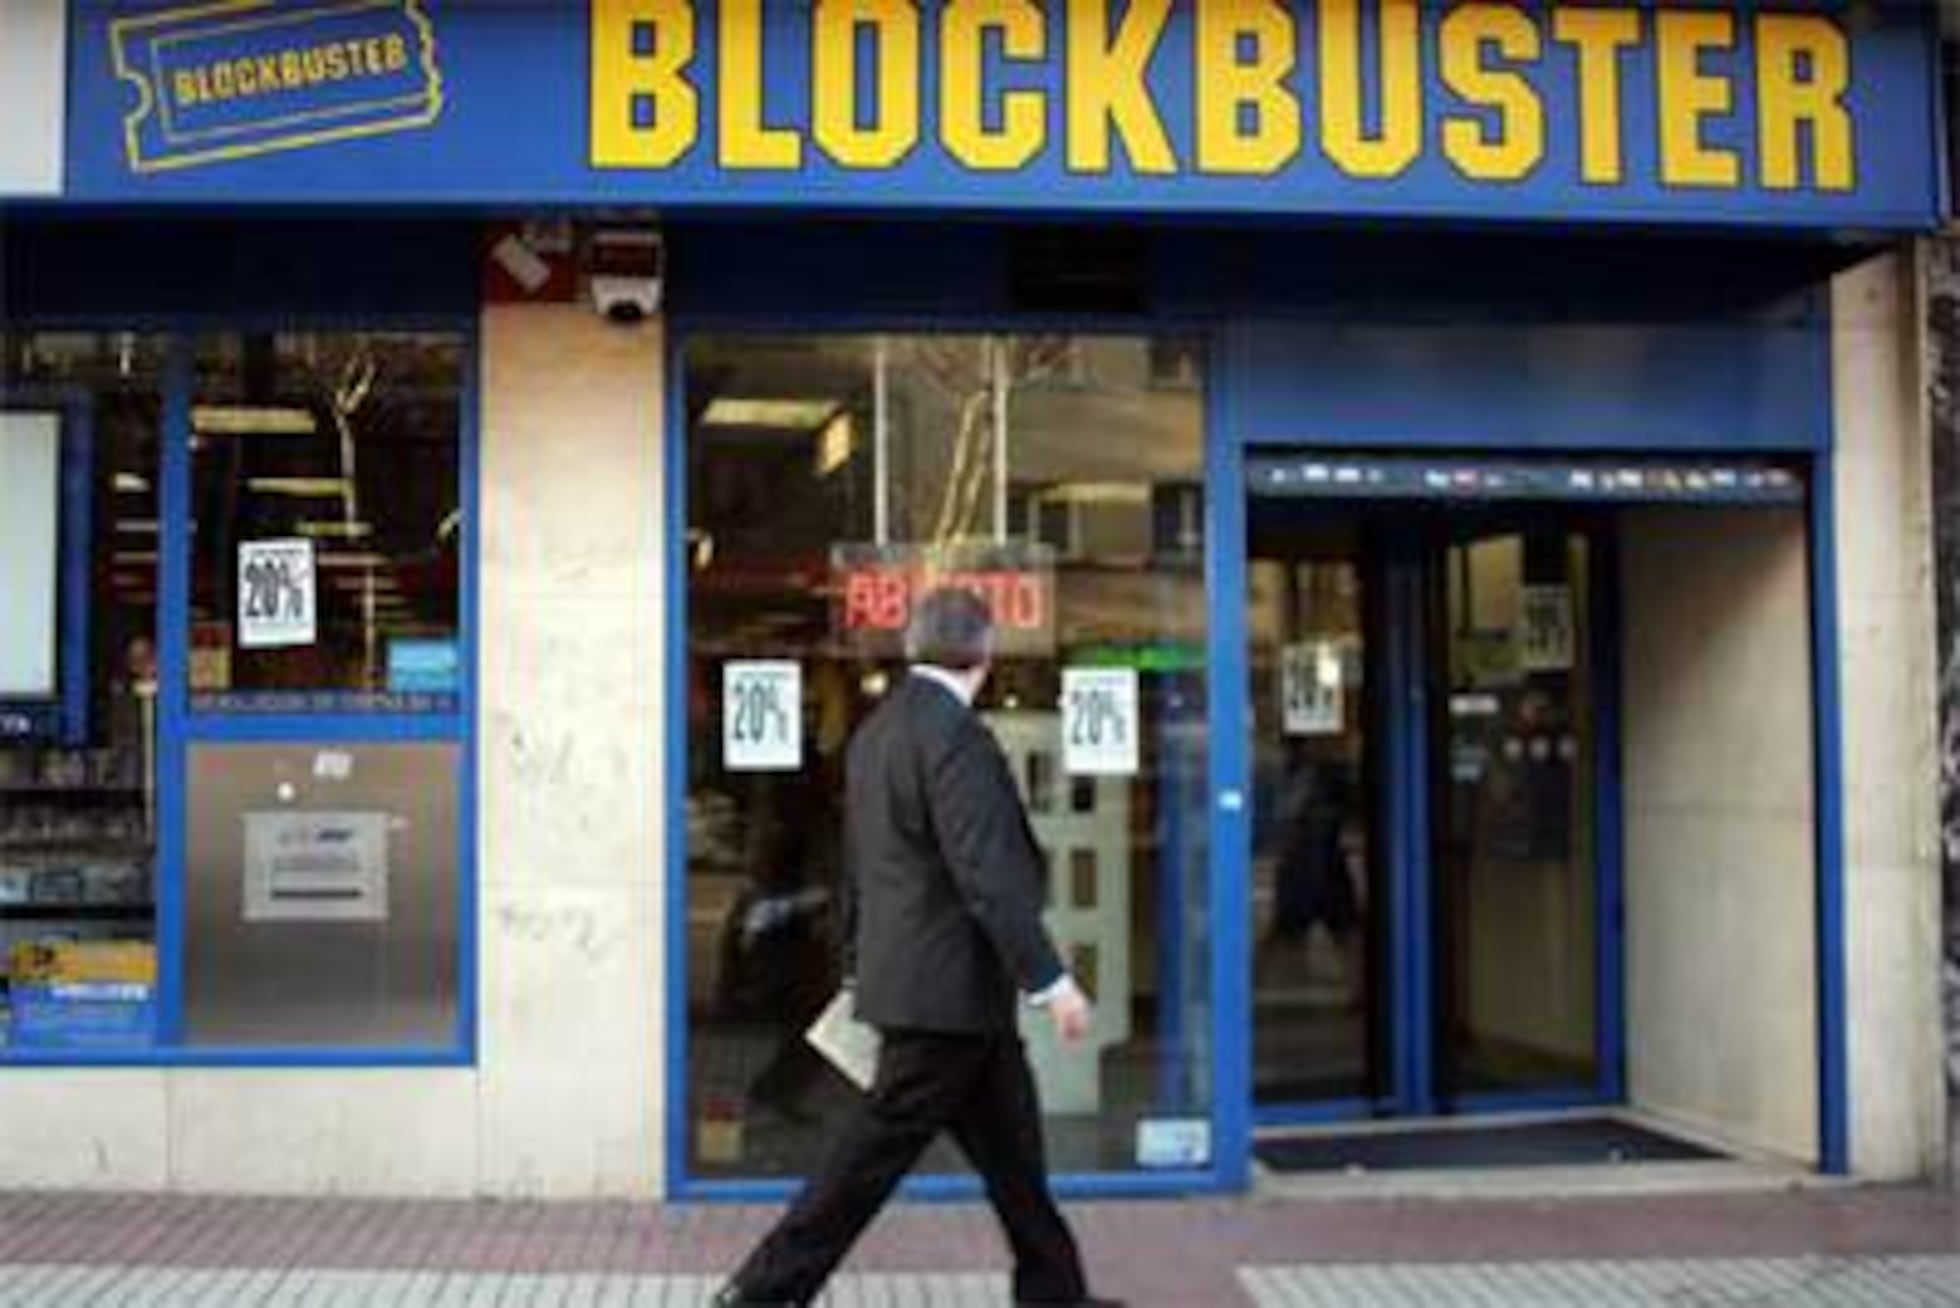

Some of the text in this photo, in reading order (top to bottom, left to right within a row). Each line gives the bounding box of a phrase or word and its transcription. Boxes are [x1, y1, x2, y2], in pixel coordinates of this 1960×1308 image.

[174, 33, 406, 104] BLOCKBUSTER
[588, 0, 1854, 190] BLOCKBUSTER
[244, 560, 304, 619] 20%
[846, 568, 1043, 629] ABTO
[733, 682, 789, 745] 20%
[1072, 690, 1127, 746] 20%
